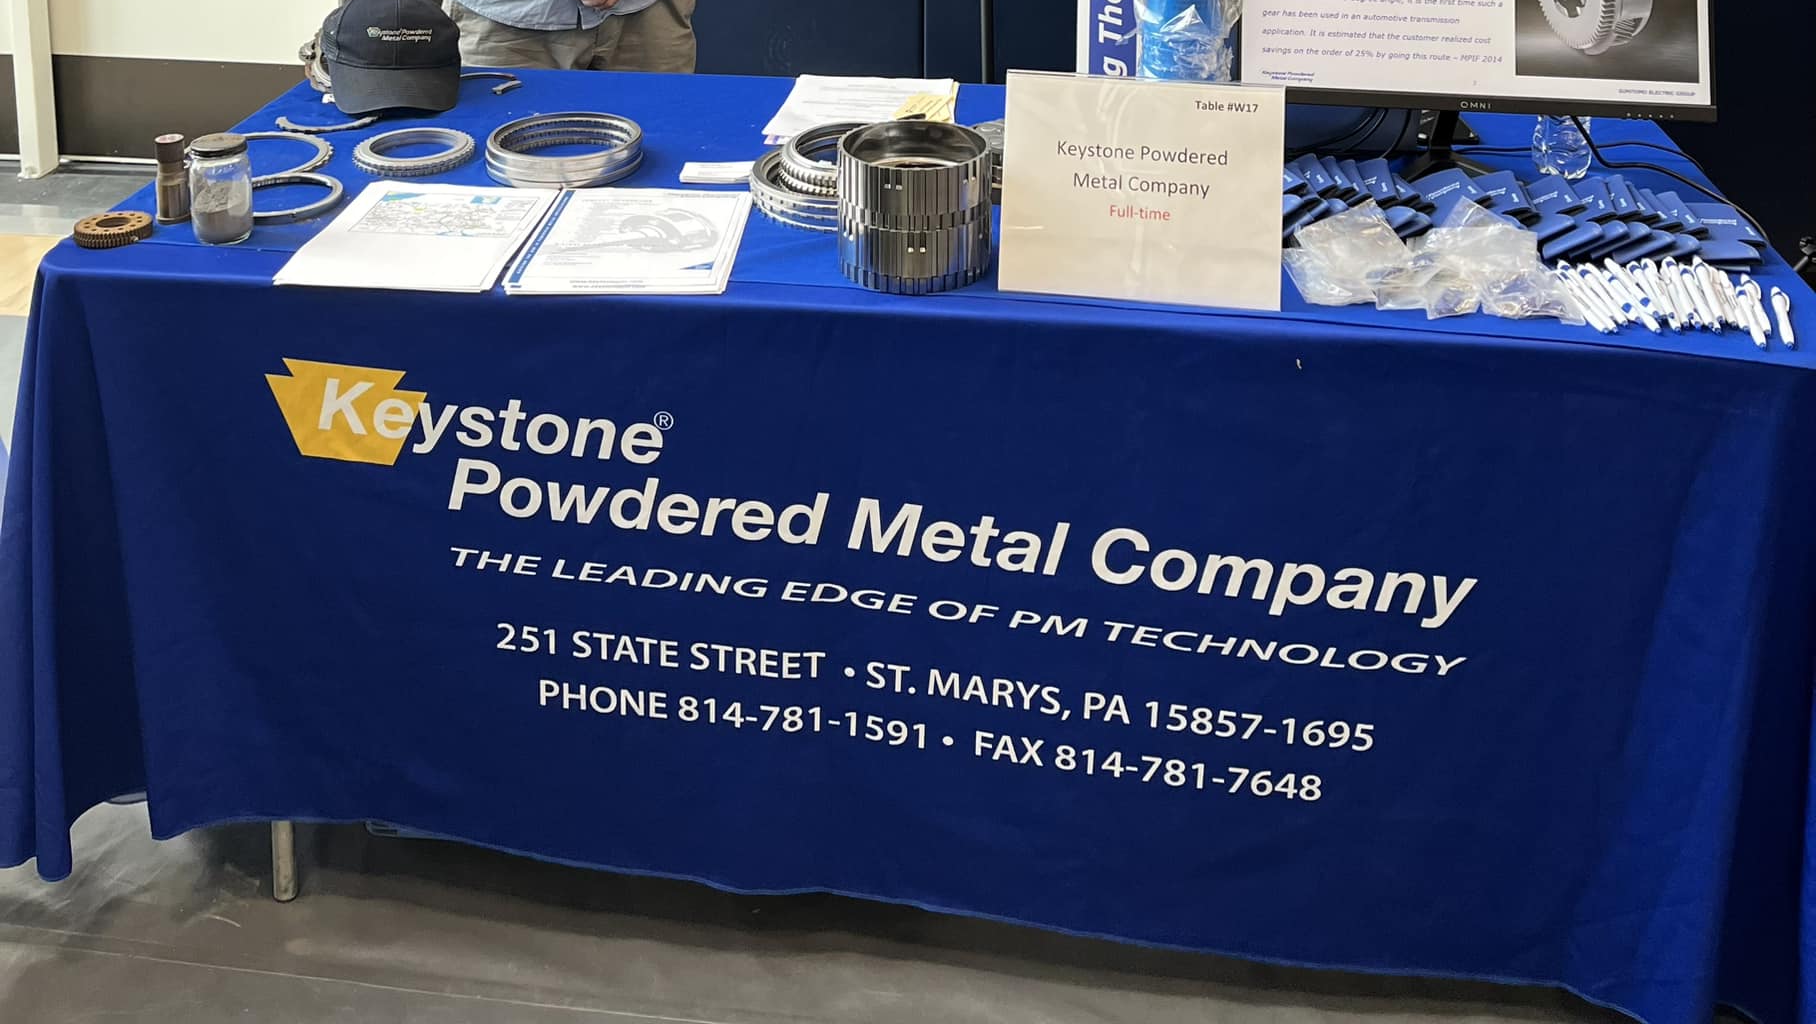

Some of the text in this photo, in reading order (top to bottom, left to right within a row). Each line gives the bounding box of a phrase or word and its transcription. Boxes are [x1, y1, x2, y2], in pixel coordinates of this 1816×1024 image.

[1195, 100, 1259, 113] Table #W17
[1460, 101, 1491, 109] OMNI
[1057, 141, 1228, 166] Keystone Powdered
[1073, 173, 1210, 199] Metal Company
[1109, 204, 1171, 221] Full-time
[448, 458, 1478, 629] Powdered Metal Company
[450, 547, 1467, 676] THE LEADING EDGE OF PM TECHNOLOGY
[496, 623, 1375, 752] 251 STATE STREET ST. MARYS, PA 15857-1695
[539, 679, 1323, 801] PHONE 814-781-1591 FAX 814-781-7648
